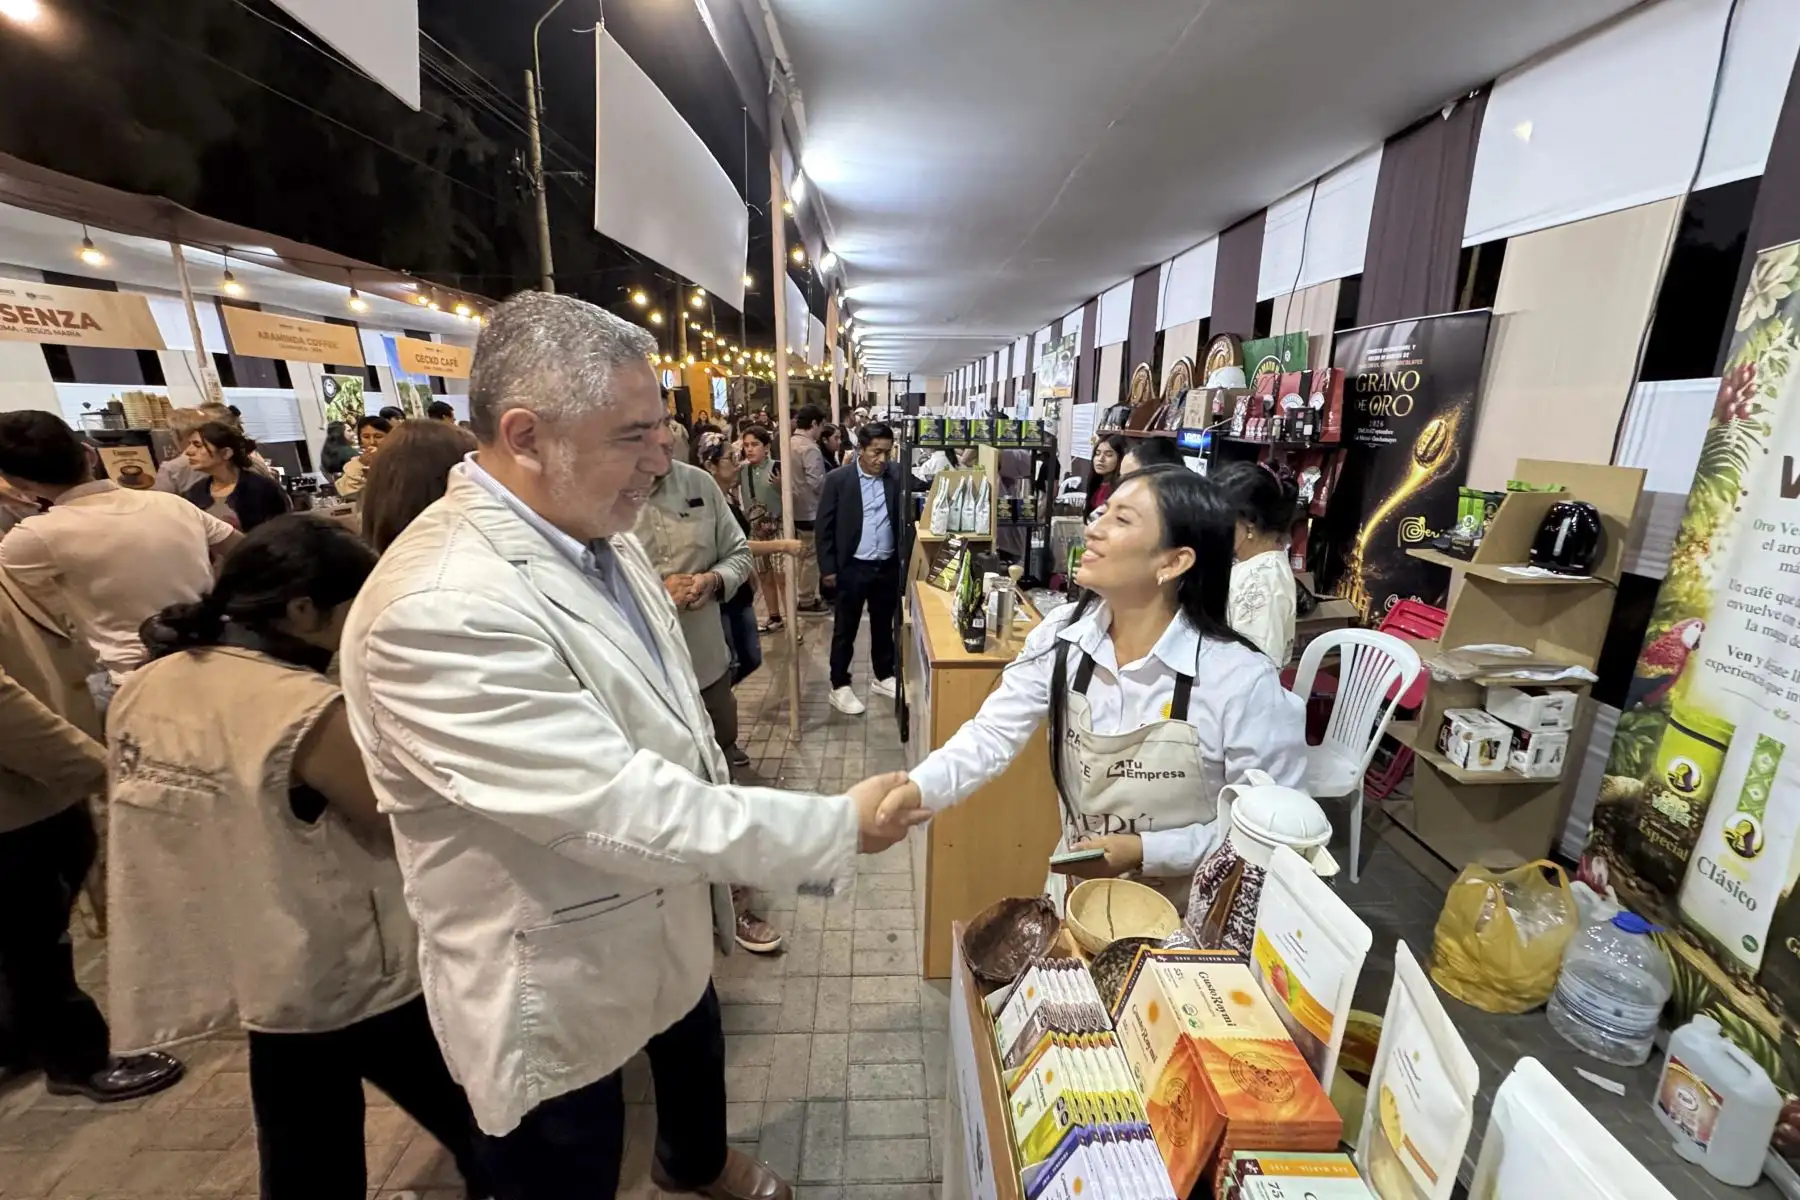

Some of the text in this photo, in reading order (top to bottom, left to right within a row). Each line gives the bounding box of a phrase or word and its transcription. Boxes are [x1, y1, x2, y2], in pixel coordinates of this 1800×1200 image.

[440, 356, 459, 368] CAFÉ
[1355, 370, 1421, 392] GRANO
[1369, 394, 1414, 417] ORO
[1753, 518, 1776, 533] Oro
[1762, 539, 1775, 551] el
[1743, 584, 1773, 600] café
[1727, 599, 1782, 620] envuelve
[1745, 619, 1758, 632] la
[1727, 644, 1753, 662] Ven
[1126, 759, 1142, 769] Tu
[1126, 769, 1186, 782] Empresa
[1638, 818, 1689, 862] Especial
[1697, 855, 1757, 912] Clásico
